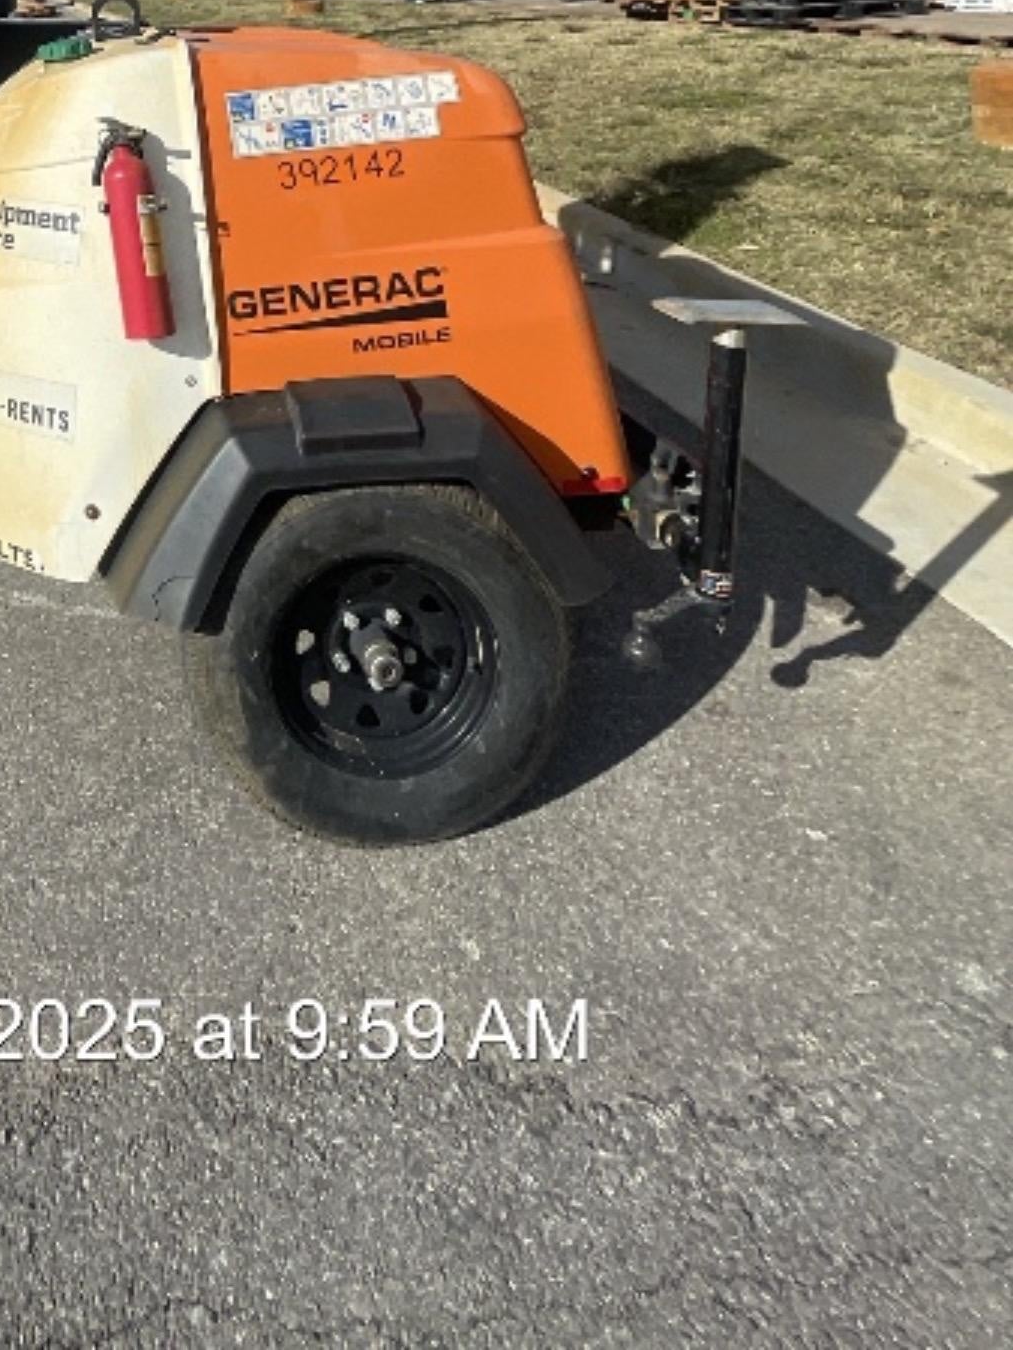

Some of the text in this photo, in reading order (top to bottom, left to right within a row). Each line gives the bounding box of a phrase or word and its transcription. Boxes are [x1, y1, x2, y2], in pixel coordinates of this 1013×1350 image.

[278, 149, 406, 190] 392142
[227, 266, 445, 320] GENERAC
[352, 327, 452, 354] MOBILE
